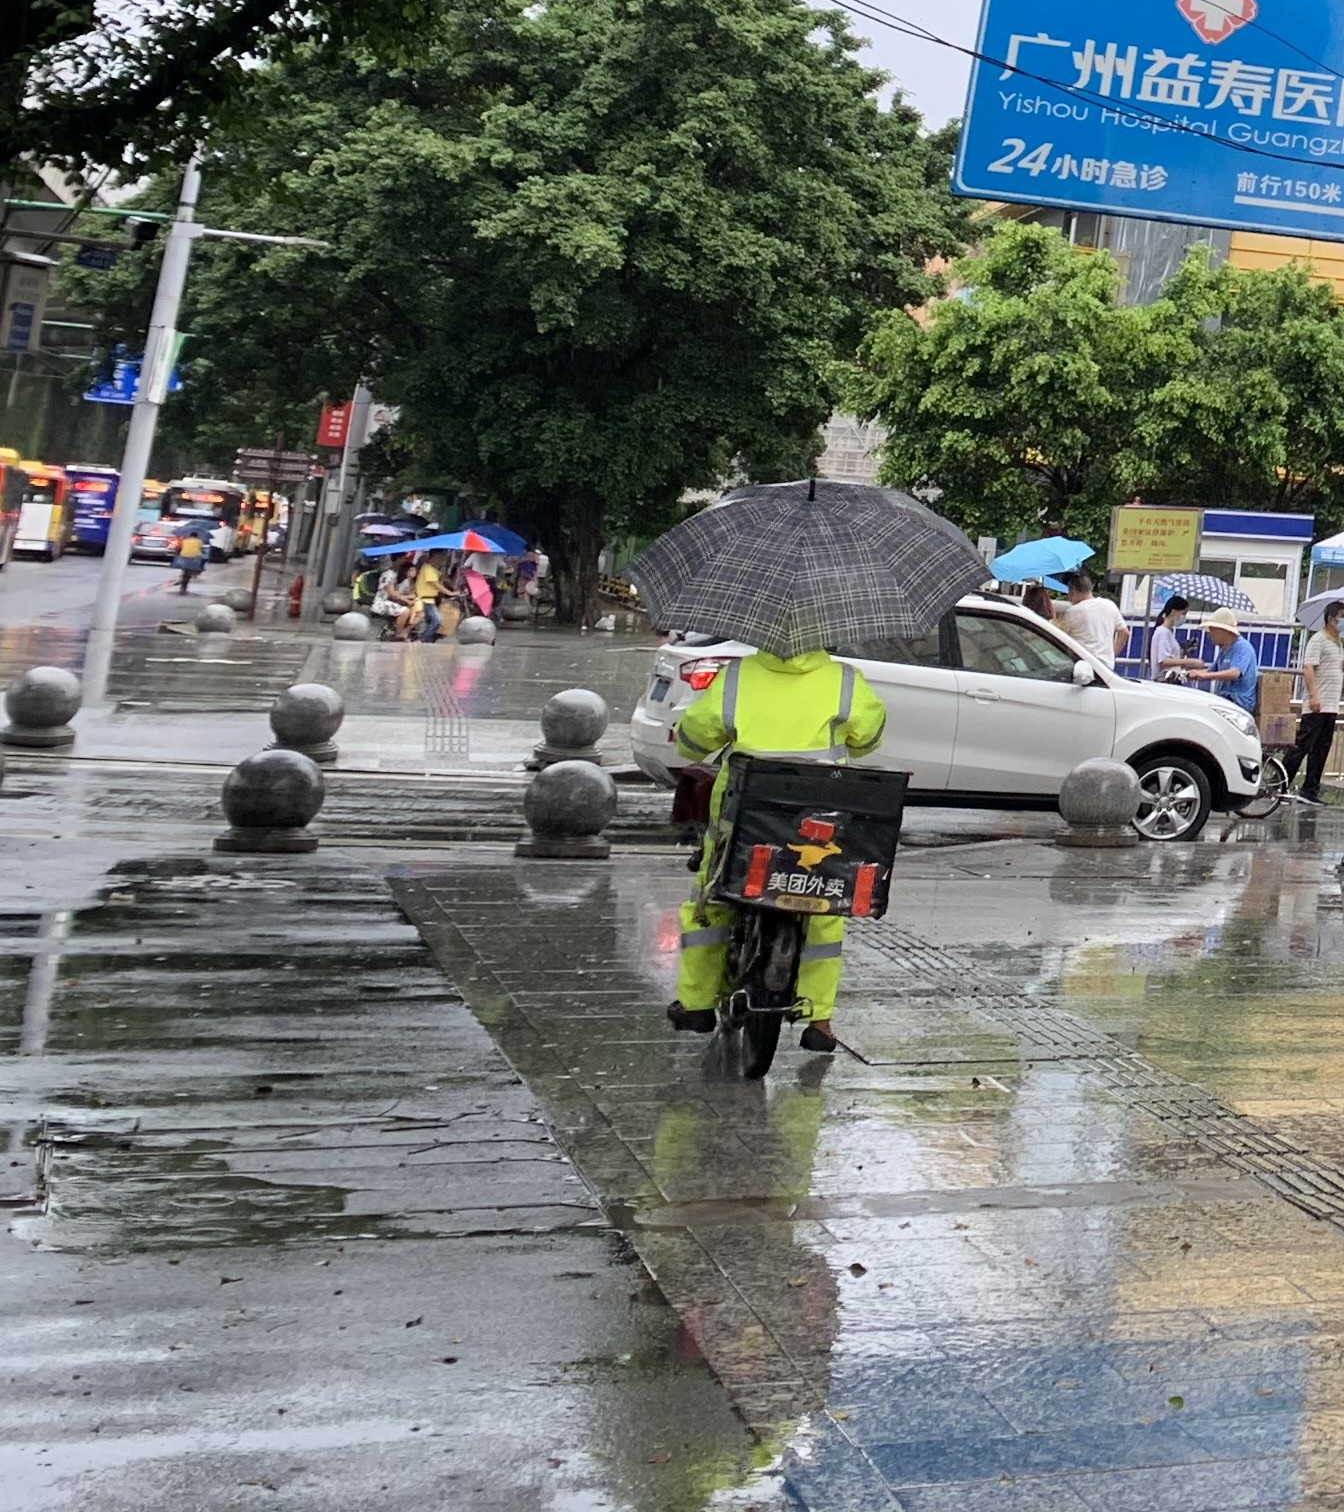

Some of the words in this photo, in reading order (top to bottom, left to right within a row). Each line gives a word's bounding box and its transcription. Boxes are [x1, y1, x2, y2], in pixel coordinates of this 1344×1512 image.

[998, 90, 1089, 122] Yishou
[1100, 106, 1217, 141] Hospital
[986, 137, 1168, 191] 24小时急诊
[1236, 172, 1343, 204] 前行150米
[766, 872, 845, 898] 美团外卖
